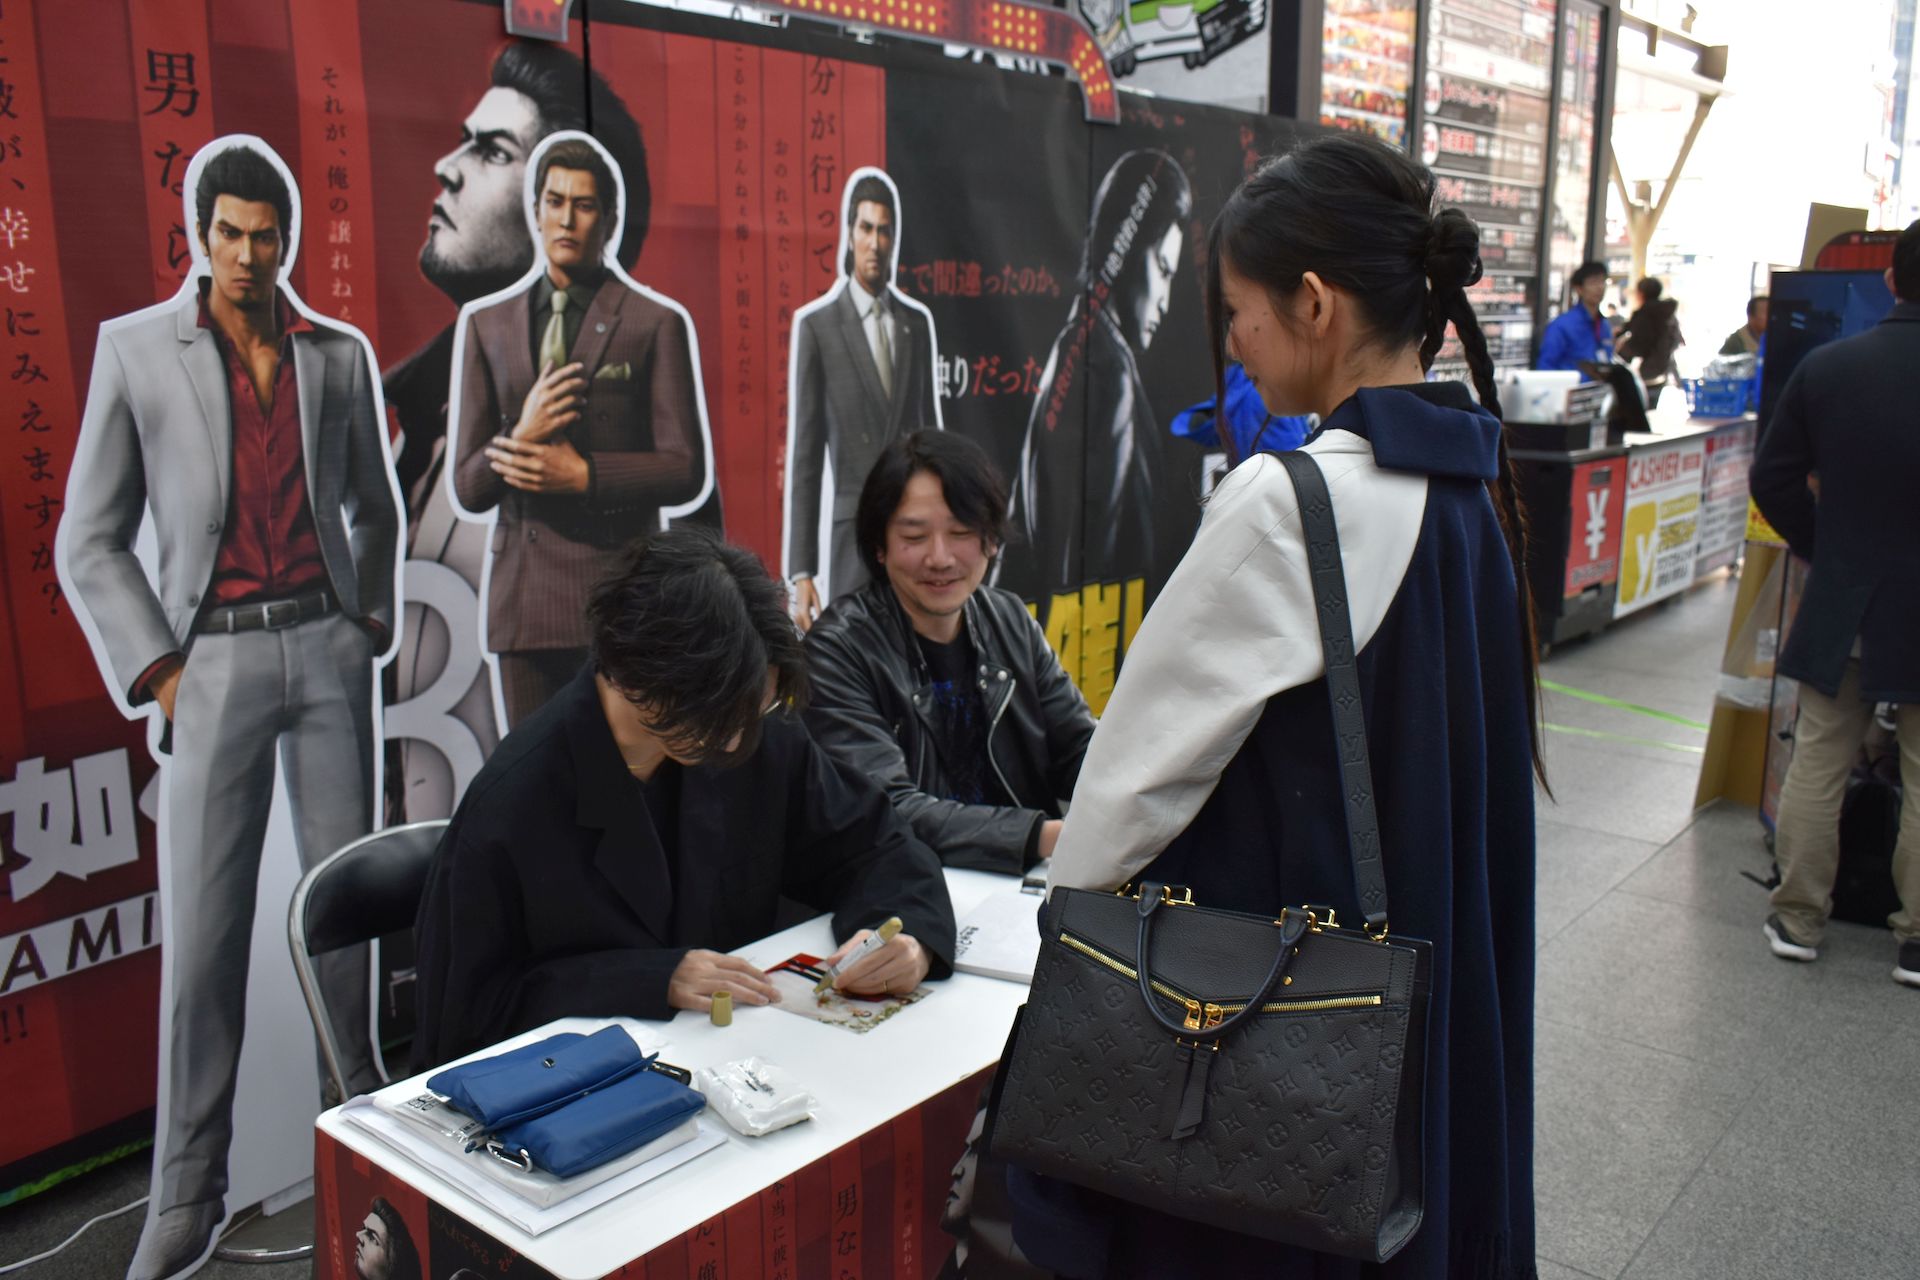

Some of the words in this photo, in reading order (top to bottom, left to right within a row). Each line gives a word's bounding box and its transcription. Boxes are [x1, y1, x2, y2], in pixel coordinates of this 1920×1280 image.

[810, 56, 837, 296] 分が行って
[0, 38, 61, 616] が、幸せにみえますか?
[1630, 453, 1680, 490] CASHIER
[1, 895, 154, 993] AMI
